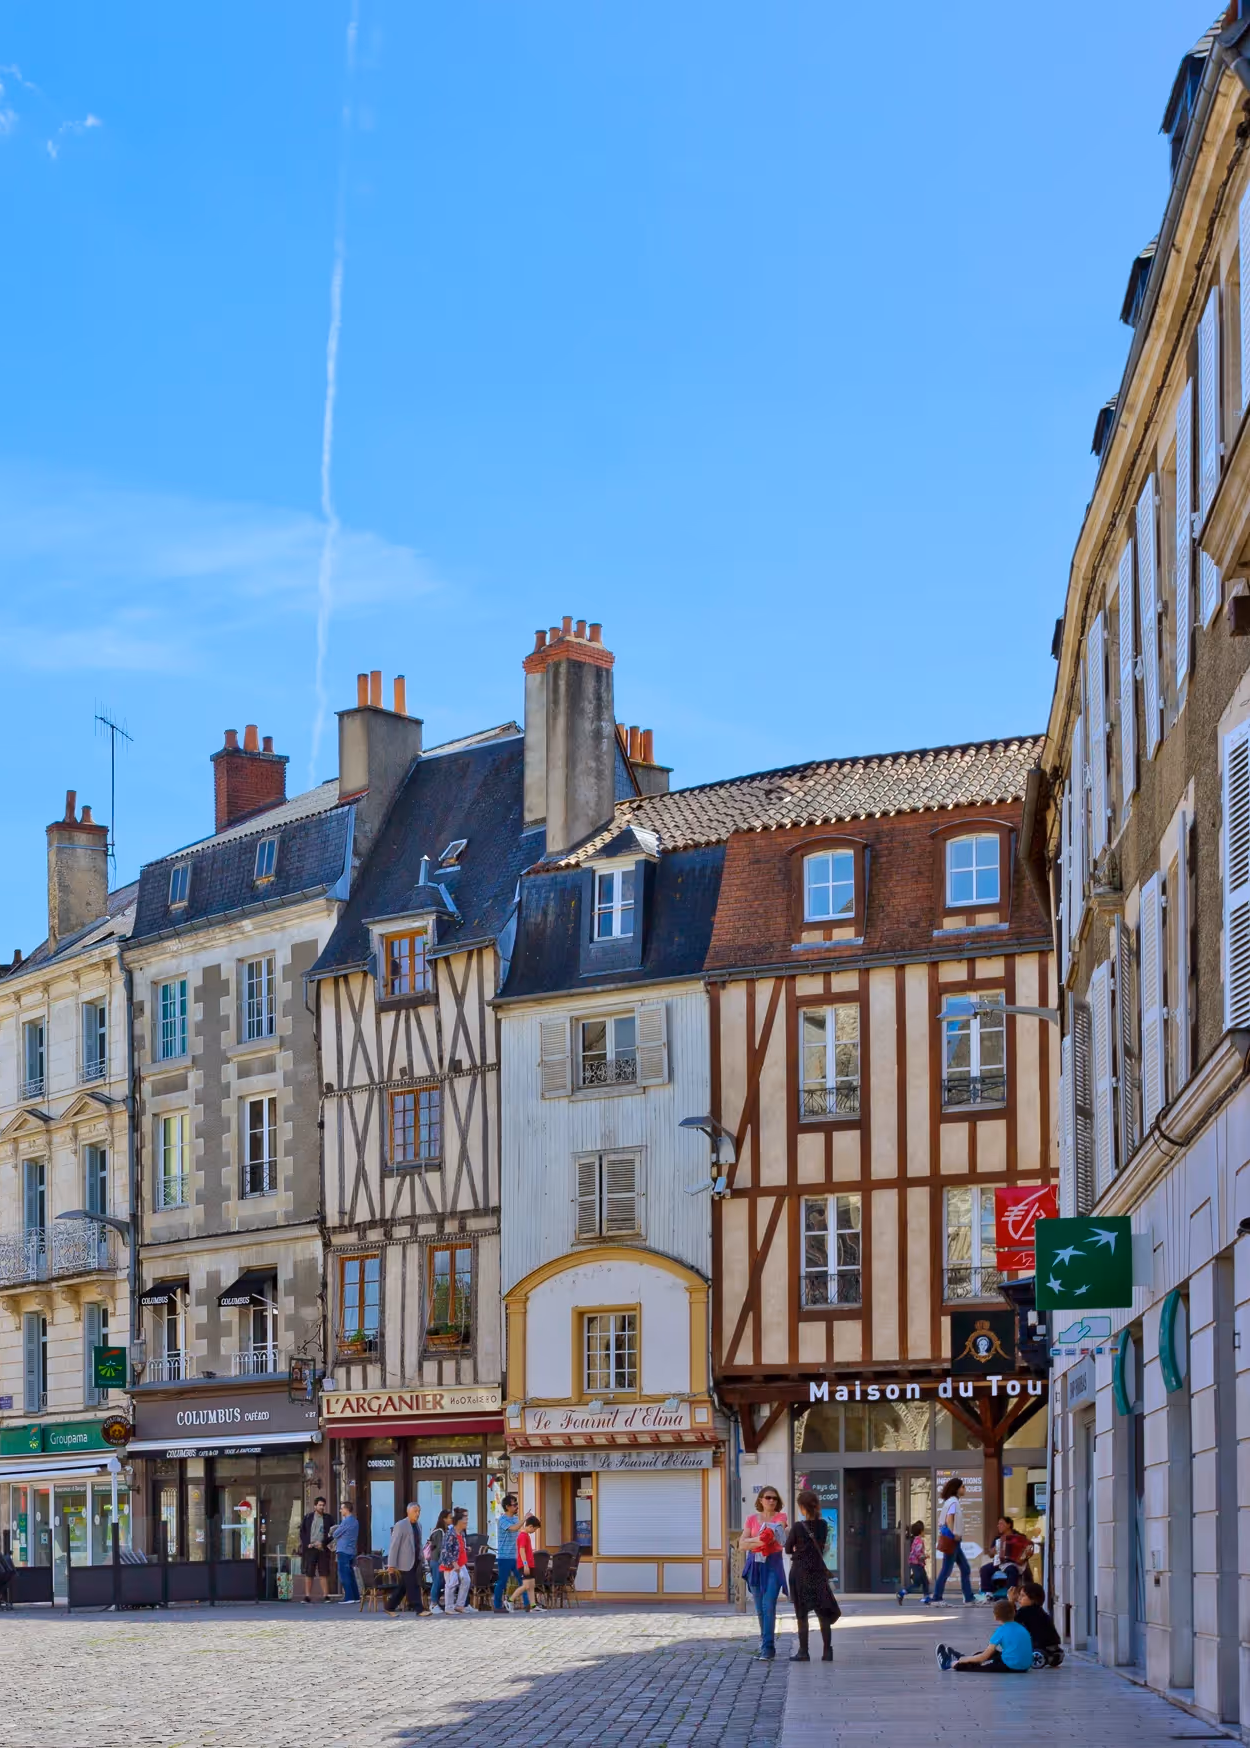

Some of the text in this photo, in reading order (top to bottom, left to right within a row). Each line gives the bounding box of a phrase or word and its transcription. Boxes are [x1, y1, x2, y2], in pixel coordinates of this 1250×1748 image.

[141, 1296, 169, 1305] COLUMBUS
[221, 1296, 250, 1306] COLUMBUS
[809, 1375, 1042, 1402] Maison du Tou
[325, 1393, 445, 1415] L'ARGANIER
[177, 1407, 241, 1426] COLUMBUS
[532, 1406, 684, 1431] Le Fournil d'Elina
[50, 1432, 88, 1446] Groupama
[166, 1449, 197, 1458] COLUMBUS
[412, 1454, 482, 1469] RESTAURANT
[487, 1457, 499, 1465] BA
[520, 1457, 589, 1469] Pain biologique
[599, 1454, 705, 1468] Le Fournil d'Elina
